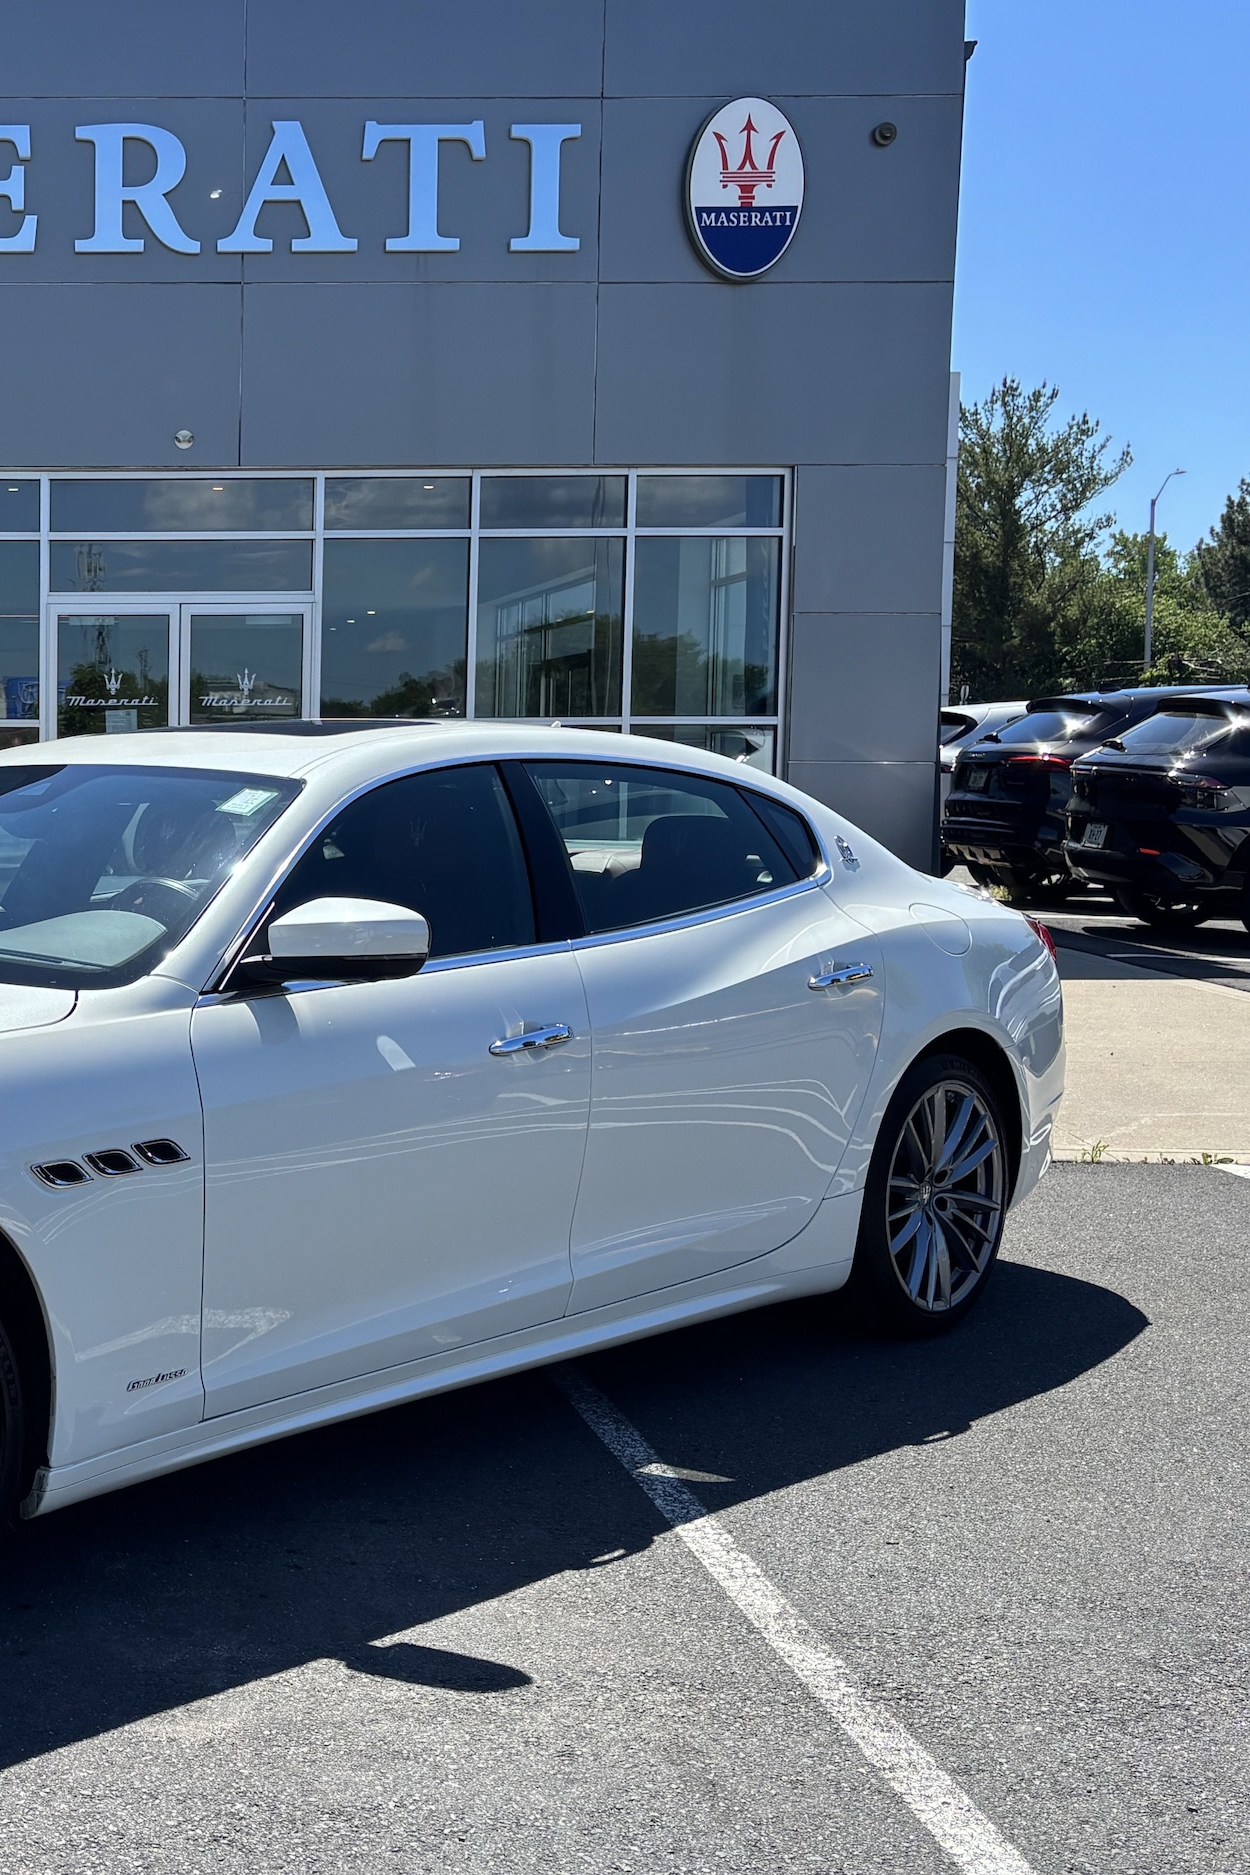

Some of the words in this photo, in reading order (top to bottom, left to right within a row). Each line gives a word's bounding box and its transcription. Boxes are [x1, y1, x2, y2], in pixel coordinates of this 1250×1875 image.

[700, 211, 792, 227] MASERATI
[66, 695, 159, 706] Maserati
[199, 695, 292, 706] Maserati
